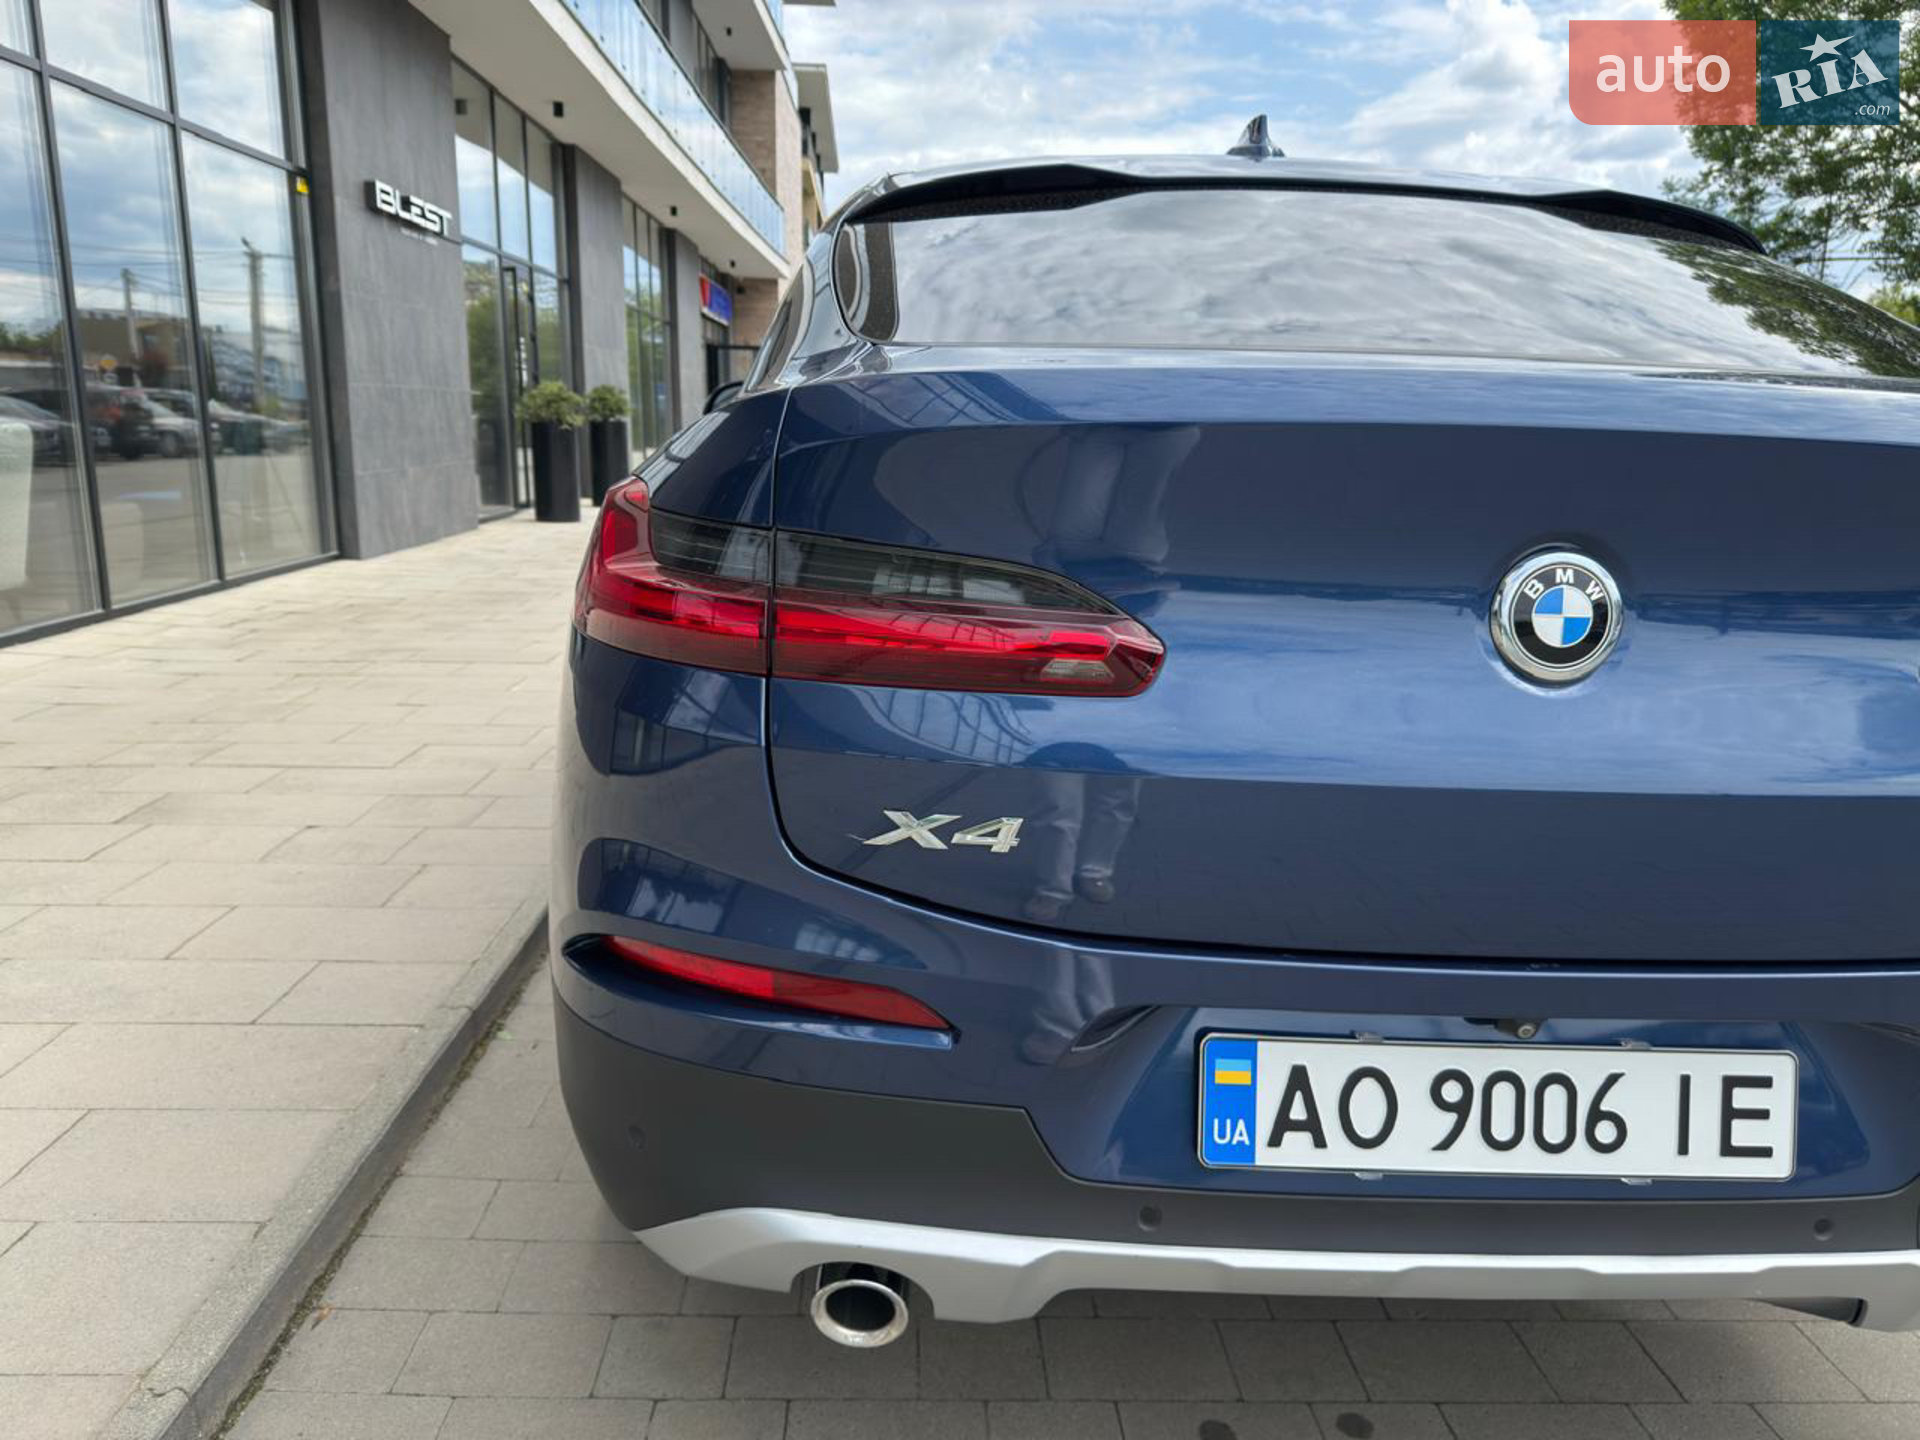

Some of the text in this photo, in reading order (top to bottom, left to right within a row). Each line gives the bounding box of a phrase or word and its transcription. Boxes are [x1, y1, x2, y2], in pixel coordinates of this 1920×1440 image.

[375, 179, 453, 236] BLEST
[1523, 568, 1605, 601] BMW
[863, 809, 1024, 853] X4
[1213, 1117, 1250, 1146] UA
[1266, 1064, 1774, 1159] AO 9006 IE
